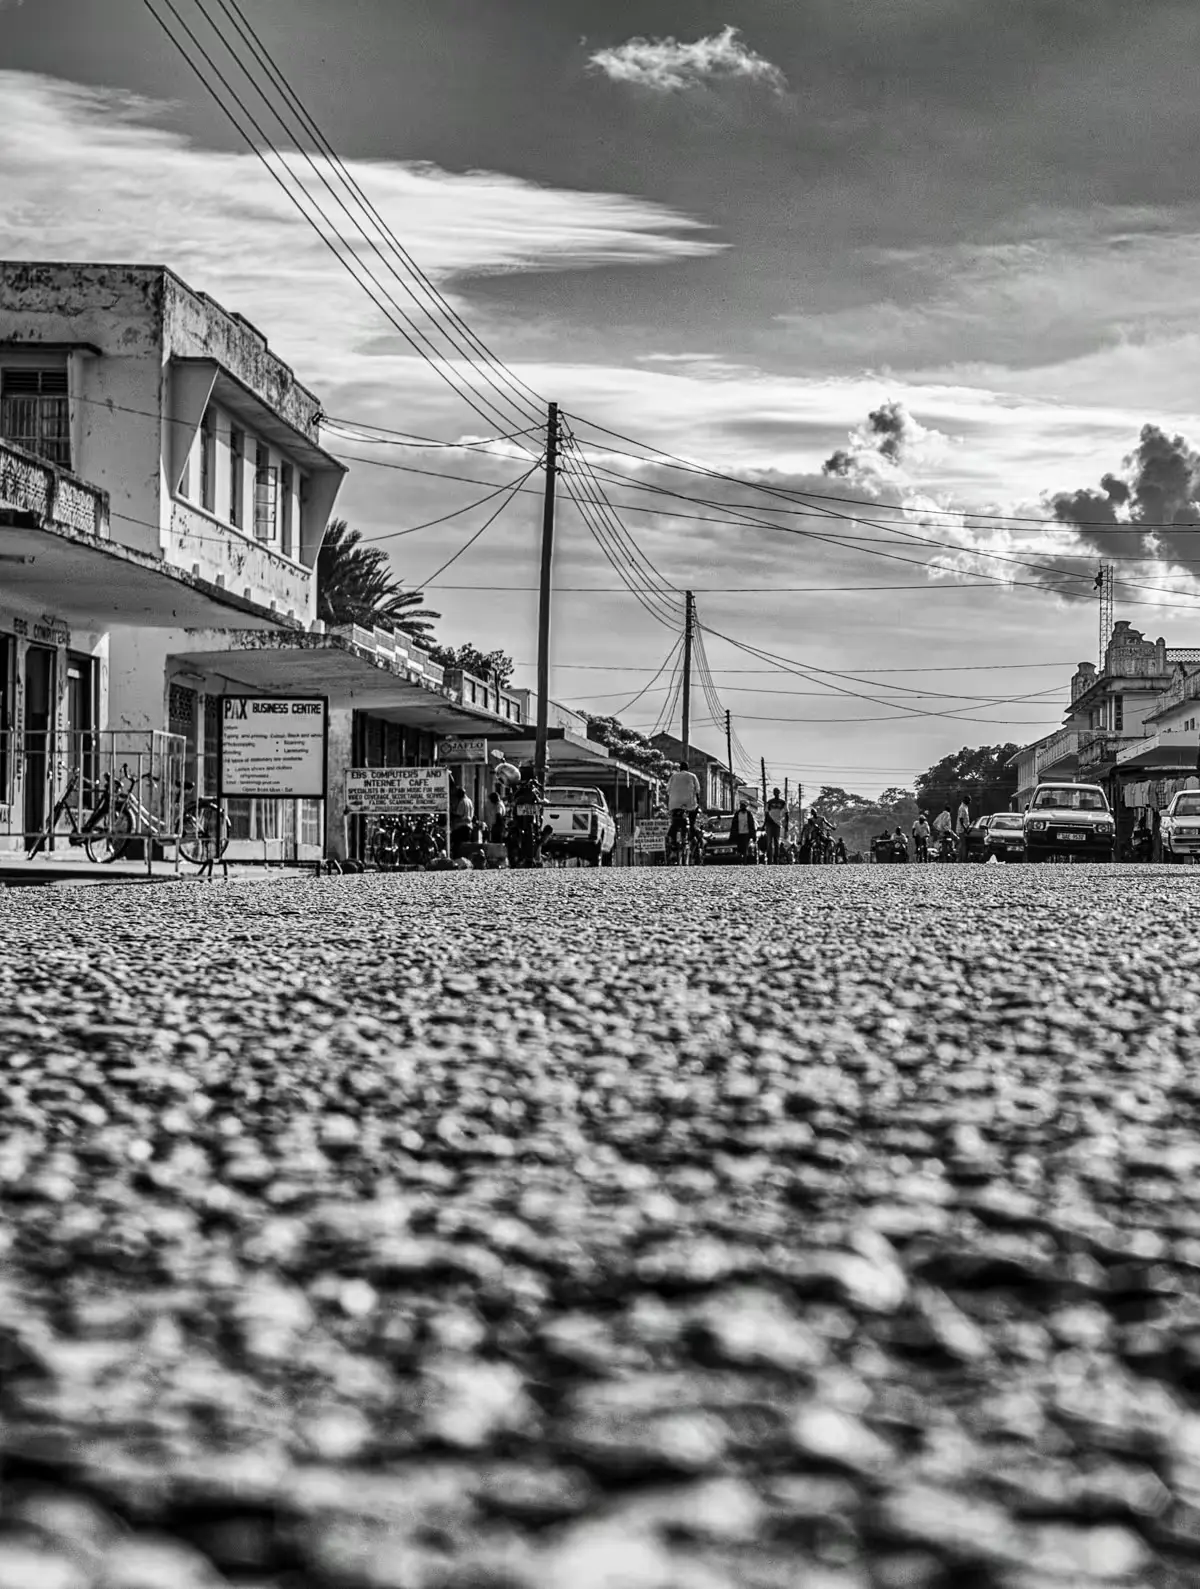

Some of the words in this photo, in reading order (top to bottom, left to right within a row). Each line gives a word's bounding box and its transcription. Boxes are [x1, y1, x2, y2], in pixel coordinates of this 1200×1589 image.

[224, 698, 248, 720] PAX
[252, 703, 289, 713] BUSINESS
[292, 703, 322, 714] CENTRE
[351, 771, 367, 779] EBS
[371, 770, 418, 779] COMPUTERS
[426, 770, 442, 778] AND
[364, 779, 401, 787] INTERNET
[409, 779, 430, 787] CAFE
